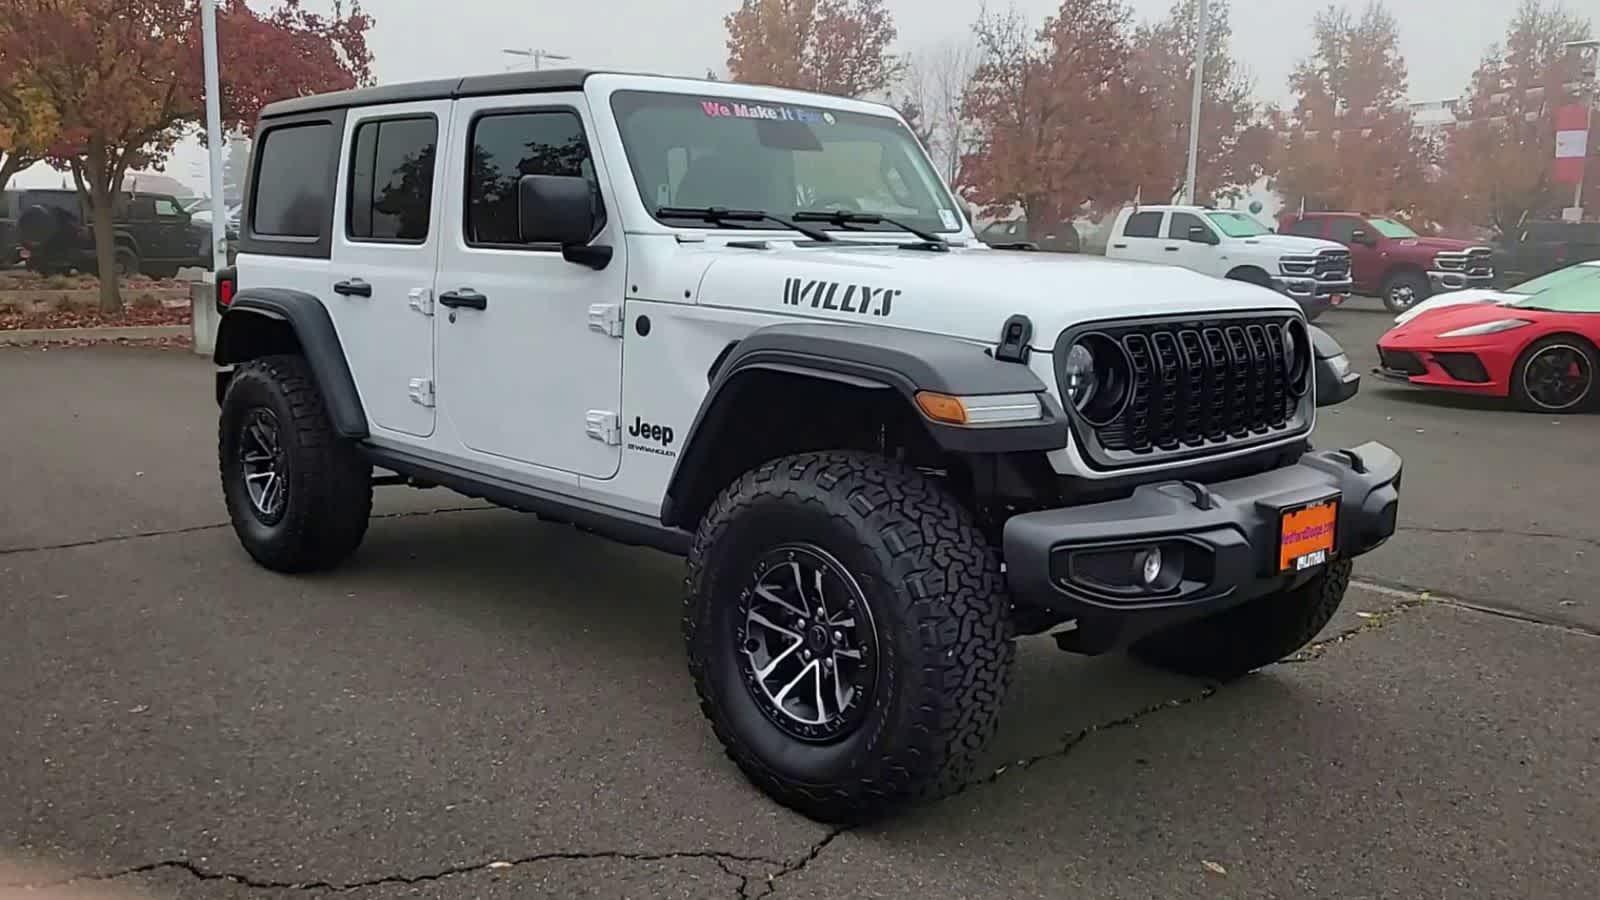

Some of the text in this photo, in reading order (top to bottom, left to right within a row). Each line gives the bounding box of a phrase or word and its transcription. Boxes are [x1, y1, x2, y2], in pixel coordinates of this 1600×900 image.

[701, 101, 730, 117] We
[732, 103, 778, 120] Make
[779, 106, 794, 120] It
[783, 277, 902, 317] WILLYS
[628, 416, 674, 447] Jeep
